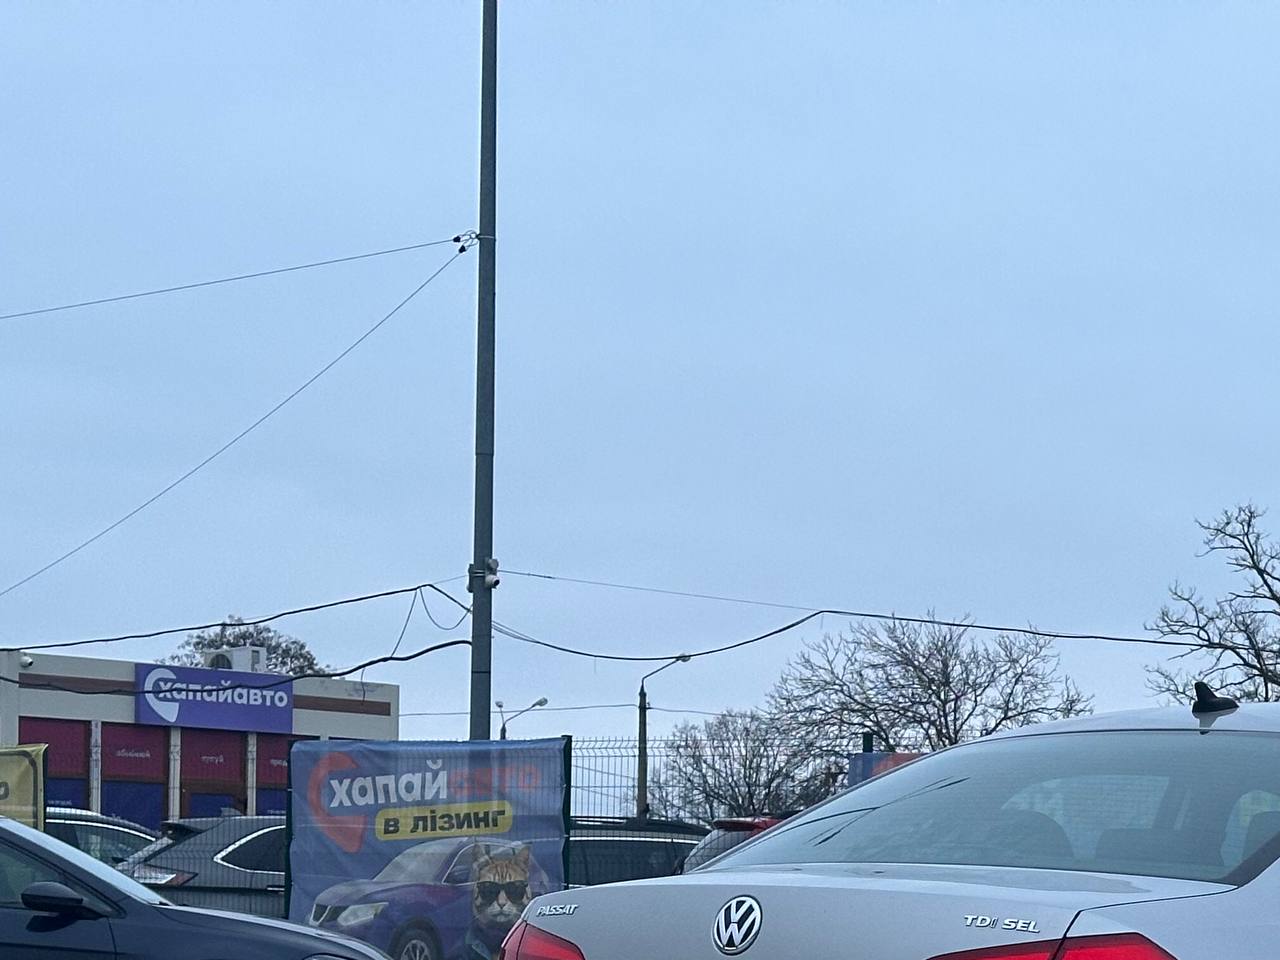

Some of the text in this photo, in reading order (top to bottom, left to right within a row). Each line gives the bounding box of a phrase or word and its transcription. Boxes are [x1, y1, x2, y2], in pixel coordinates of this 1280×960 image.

[383, 809, 506, 835] в лізинг
[536, 904, 579, 917] PASSAT
[964, 915, 1041, 934] TDI SEL
